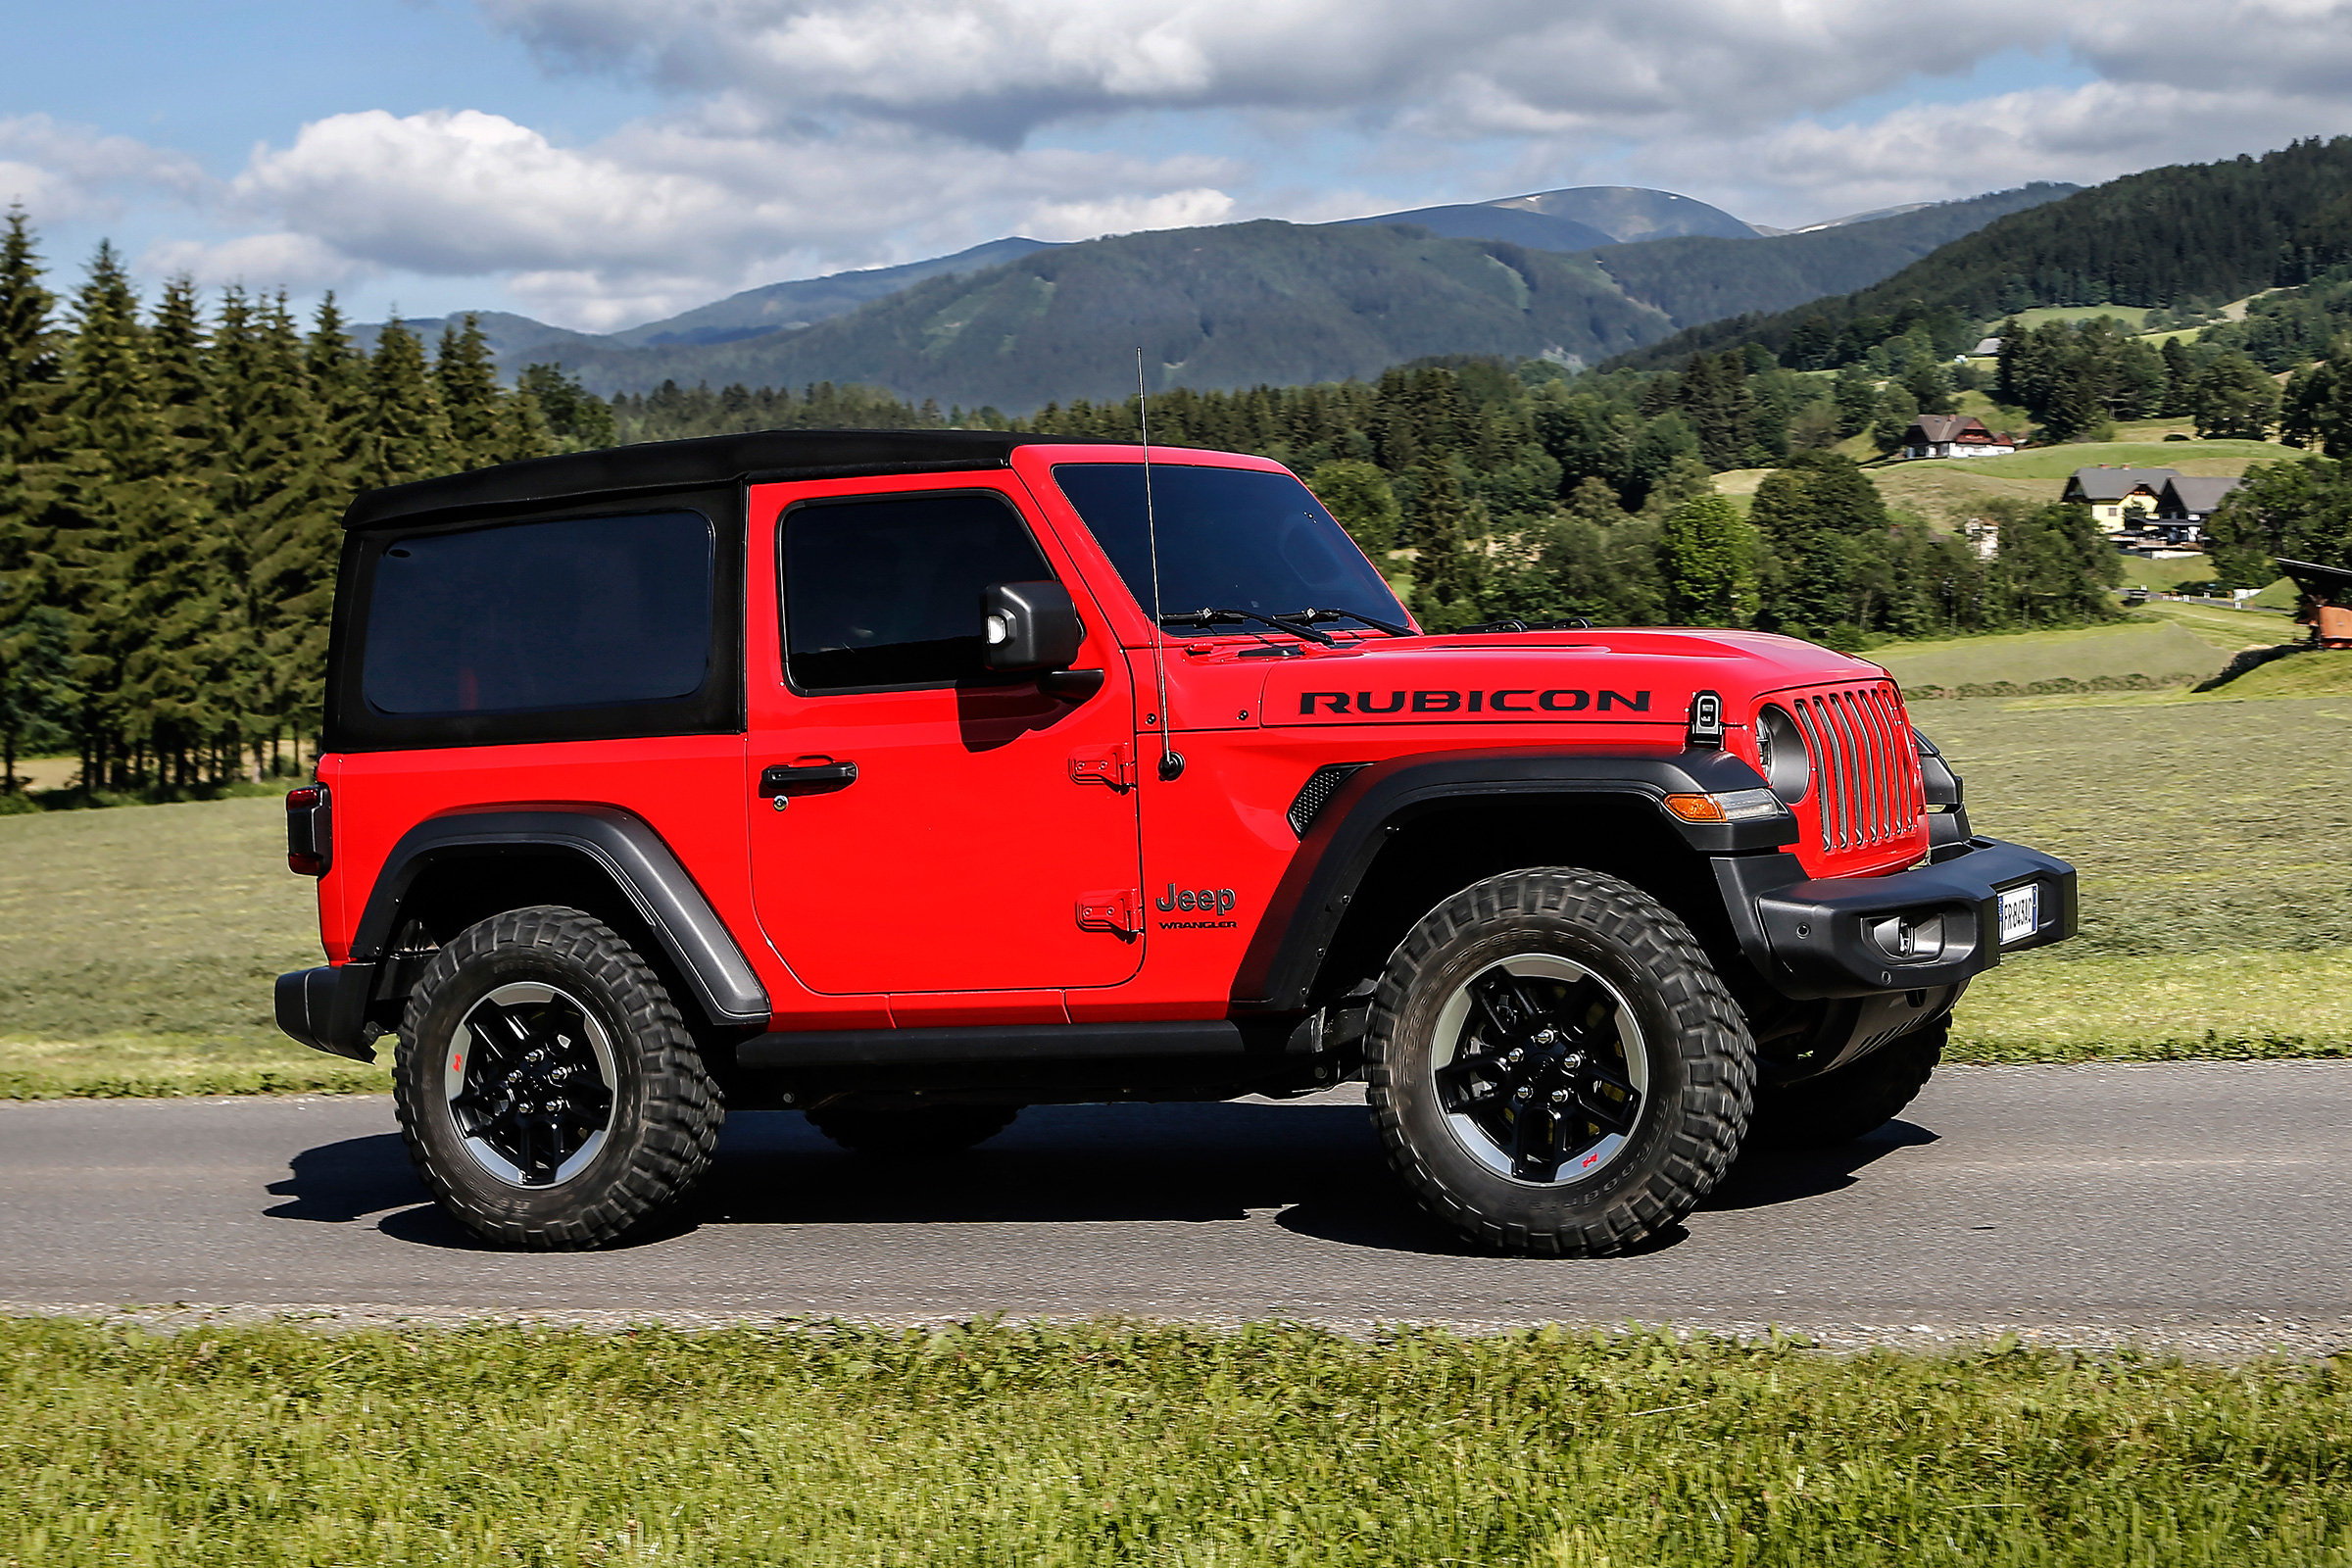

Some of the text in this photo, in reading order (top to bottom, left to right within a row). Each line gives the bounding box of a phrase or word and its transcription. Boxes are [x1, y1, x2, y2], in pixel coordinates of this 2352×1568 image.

[1298, 689, 1651, 715] RUBICON
[1156, 883, 1236, 915] Jeep
[1158, 921, 1237, 930] WRANGLER
